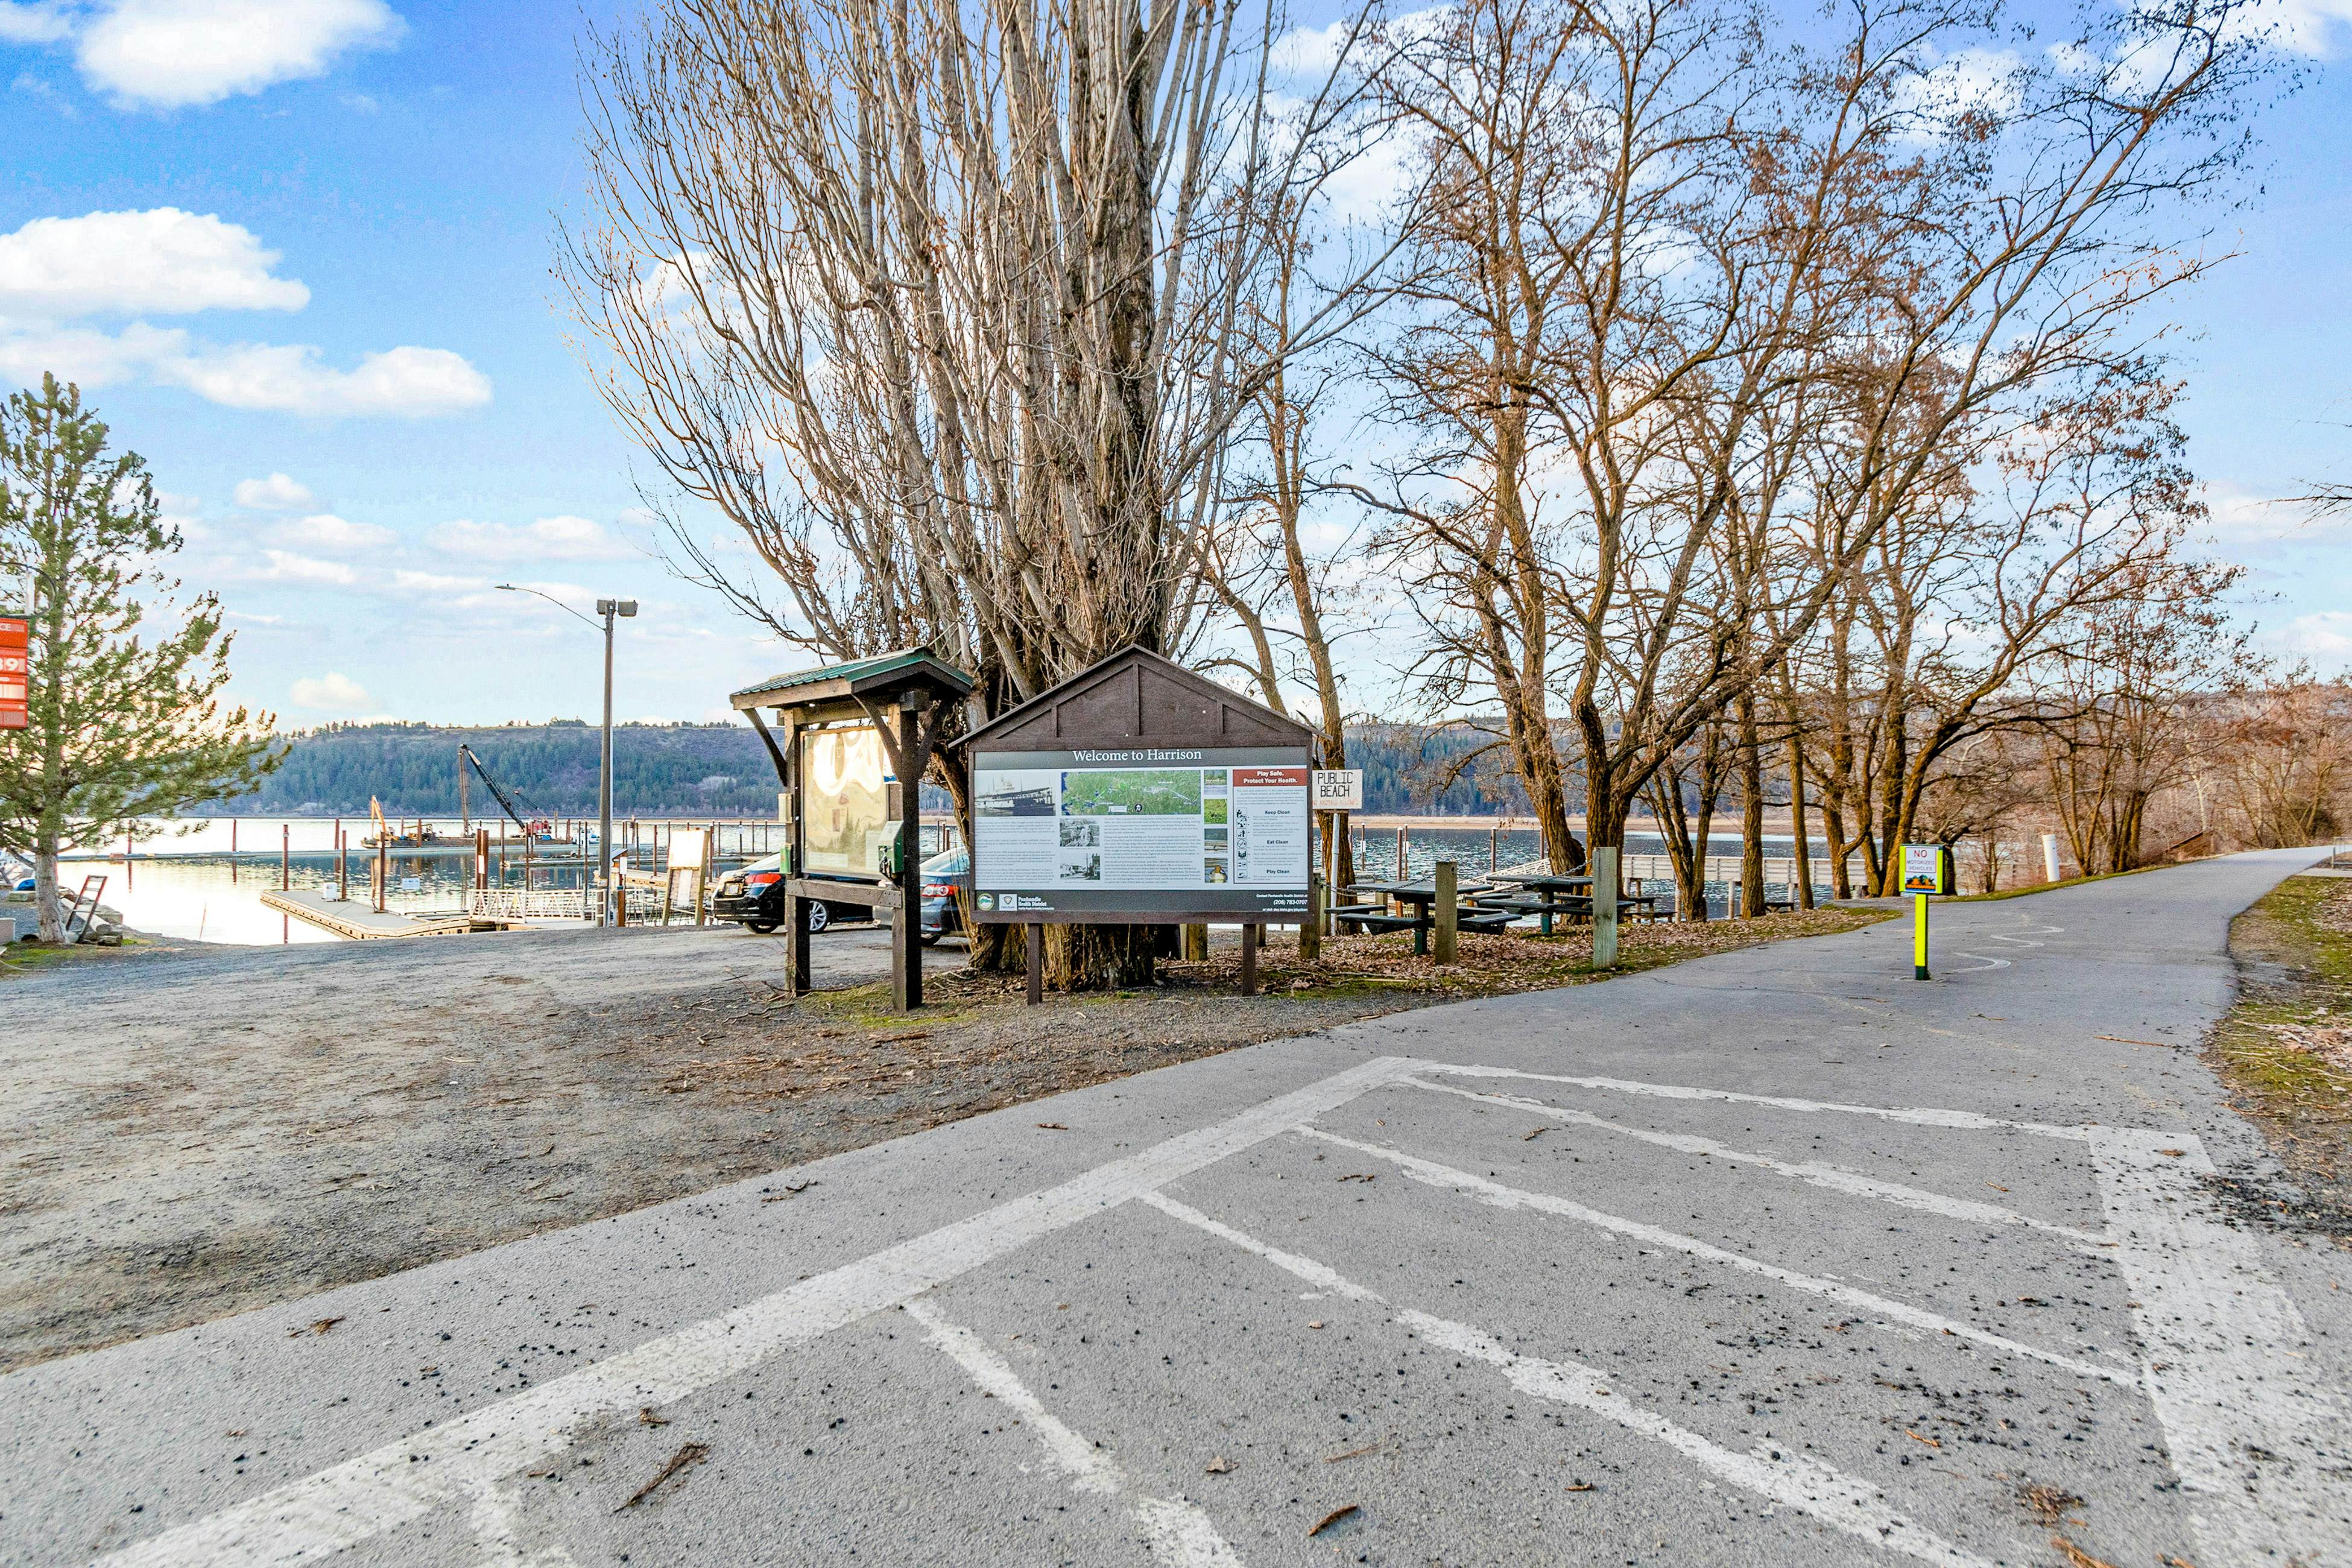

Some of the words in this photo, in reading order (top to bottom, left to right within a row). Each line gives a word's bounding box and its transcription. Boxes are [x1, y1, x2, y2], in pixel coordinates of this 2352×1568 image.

[1072, 750, 1128, 761] Welcome
[1131, 751, 1143, 760] to
[1147, 749, 1202, 760] Harrison
[1318, 772, 1353, 785] PUBLIC
[1320, 785, 1350, 797] BEACH
